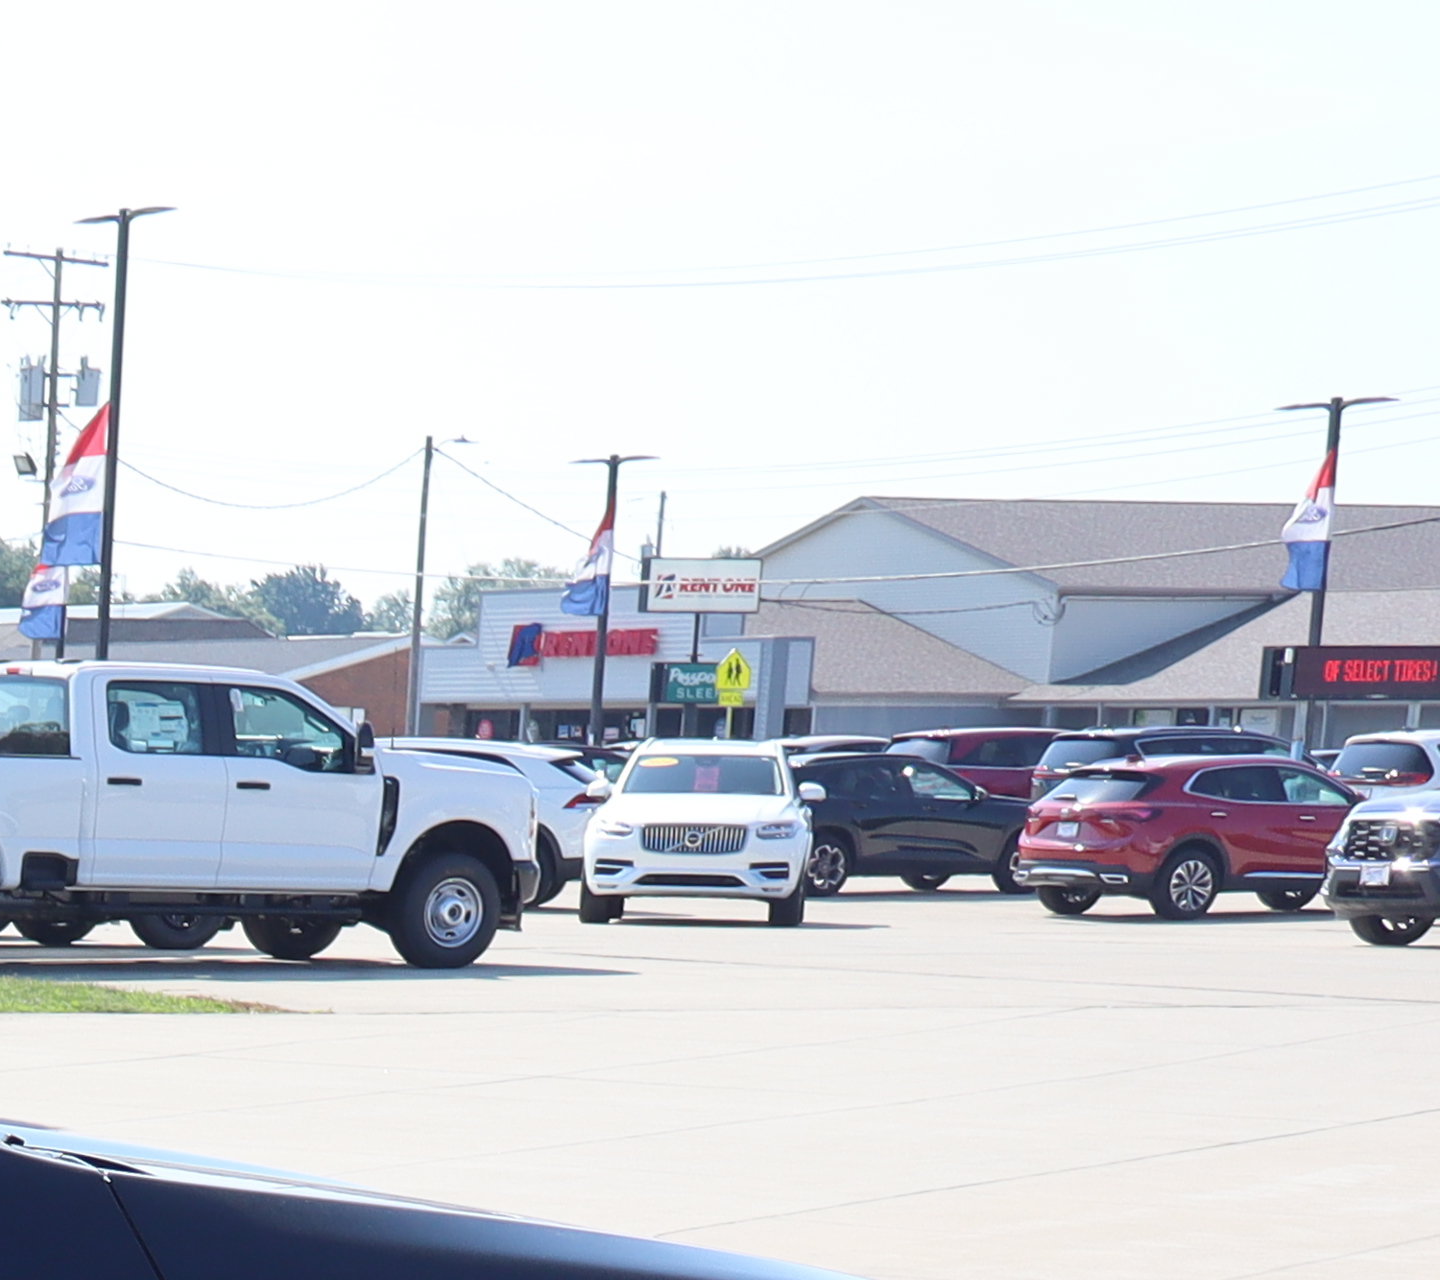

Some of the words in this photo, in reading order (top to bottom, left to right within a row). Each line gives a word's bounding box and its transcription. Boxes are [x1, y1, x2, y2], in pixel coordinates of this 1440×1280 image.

[722, 578, 758, 593] ONE
[606, 628, 659, 657] ONE
[1323, 659, 1341, 682] OF
[1342, 659, 1392, 682] SELECT
[1393, 659, 1439, 682] TIRES!
[675, 687, 717, 700] SLEE
